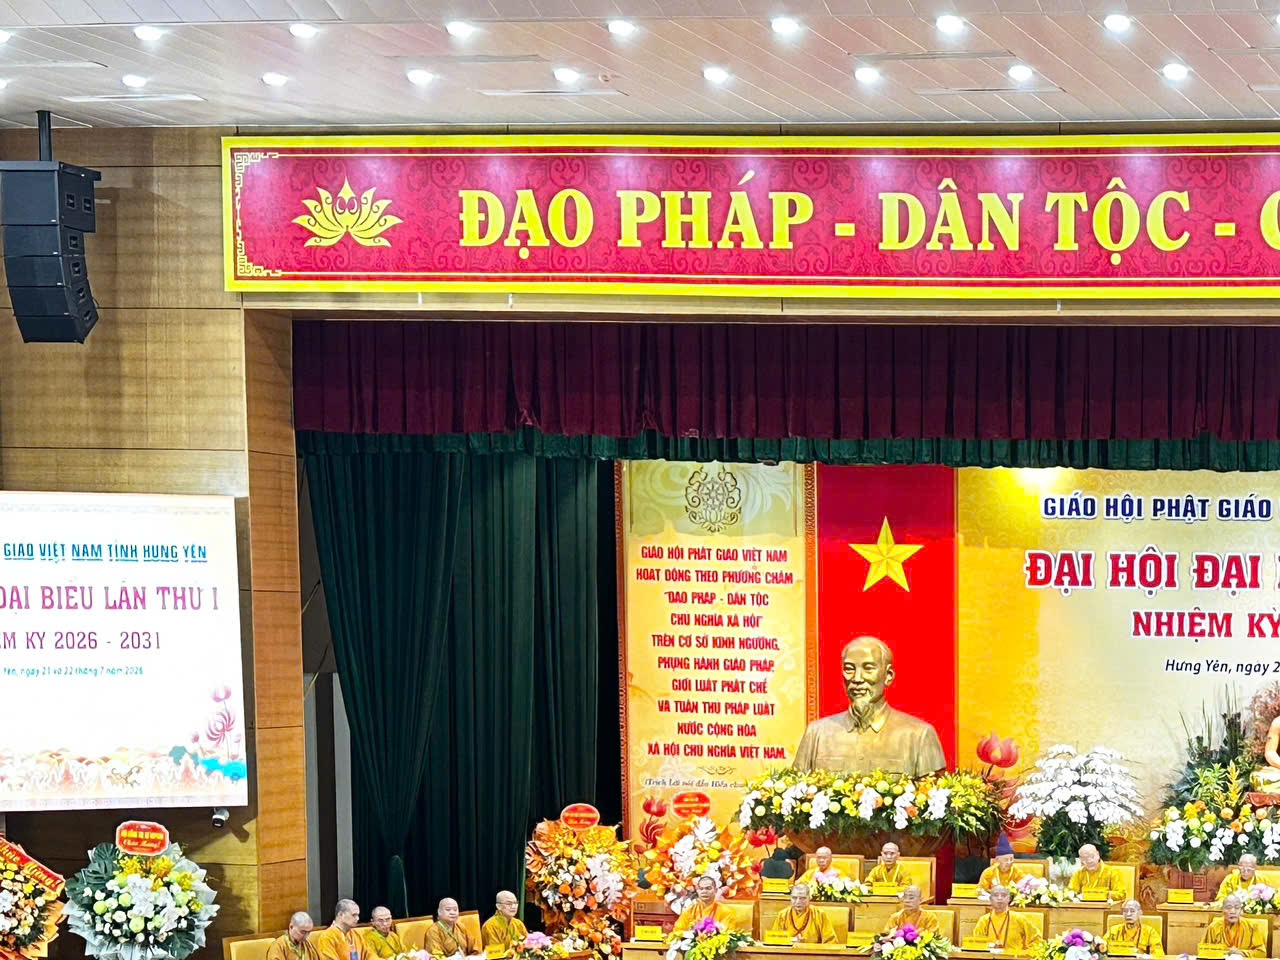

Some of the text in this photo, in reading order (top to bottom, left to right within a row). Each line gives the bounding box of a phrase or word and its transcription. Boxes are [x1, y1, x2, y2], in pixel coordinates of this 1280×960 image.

[457, 188, 594, 260] ĐẠO
[615, 169, 815, 251] PHÁP
[835, 223, 853, 234] -
[877, 179, 1024, 253] DÂN
[1046, 173, 1193, 268] TỘC
[1213, 222, 1237, 237] -
[1043, 492, 1096, 516] GIÁO
[1105, 494, 1143, 521] HỘI
[1152, 494, 1209, 522] PHẬT
[1217, 494, 1271, 517] GIÁO
[72, 544, 103, 561] NAM
[1024, 552, 1094, 596] ĐẠI
[1109, 546, 1177, 596] HỘI
[1193, 555, 1260, 597] ĐẠI
[212, 587, 218, 609] I
[1132, 607, 1233, 643] NHIỆM
[54, 632, 97, 649] 2026
[120, 632, 160, 649] 2031
[1165, 659, 1201, 675] Hưng
